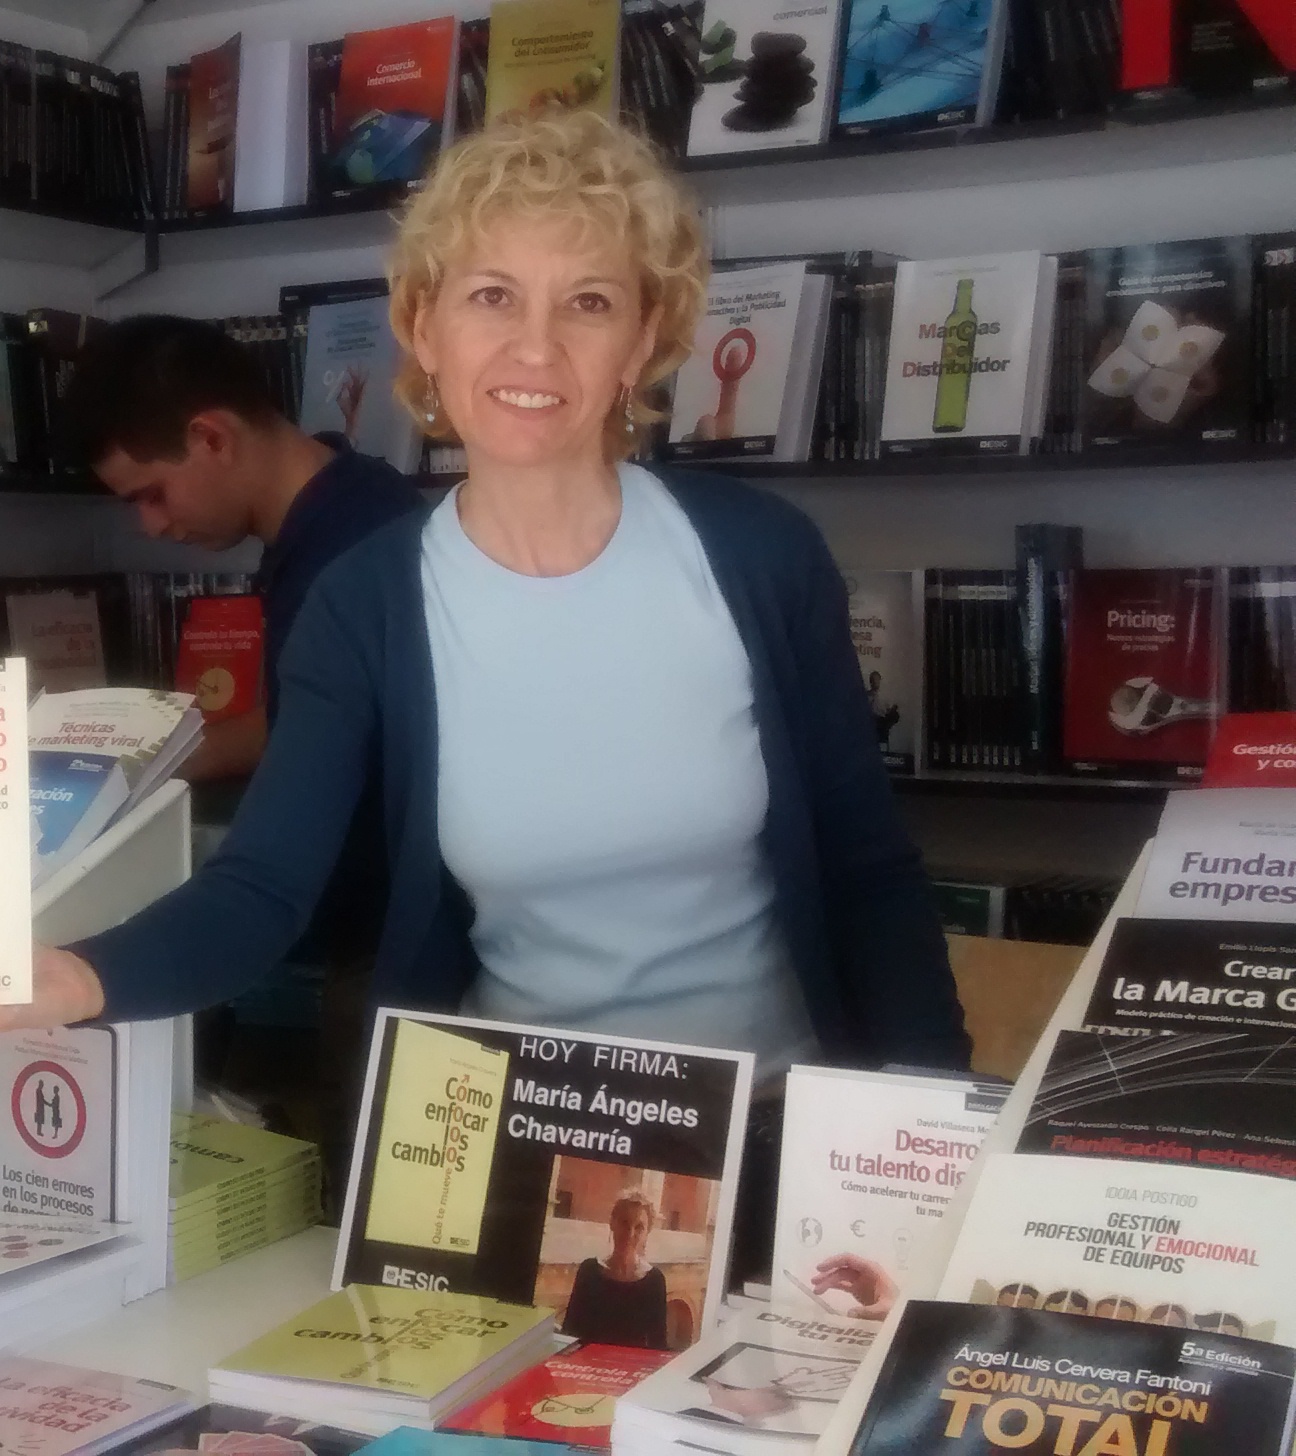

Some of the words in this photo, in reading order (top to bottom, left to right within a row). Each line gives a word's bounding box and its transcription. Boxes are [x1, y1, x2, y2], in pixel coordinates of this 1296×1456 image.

[514, 46, 530, 57] del
[366, 68, 422, 86] internacional
[375, 59, 416, 74] Comercio
[745, 291, 781, 302] Marketing
[750, 299, 787, 311] Publicidad
[729, 316, 751, 326] Digital
[902, 356, 1011, 378] Distribuidor
[1107, 610, 1176, 632] Pricing:
[58, 721, 116, 734] Técnicas
[37, 734, 110, 748] marketing
[111, 735, 145, 748] viral
[1232, 743, 1296, 756] Gestió
[1256, 760, 1270, 771] y
[1224, 960, 1296, 980] Crear
[1112, 977, 1146, 1001] la
[1154, 980, 1266, 1009] Marca
[1115, 1009, 1147, 1018] Modelo
[1148, 1010, 1183, 1020] práctico
[1184, 1013, 1196, 1021] de
[1197, 1013, 1234, 1023] creación
[519, 1036, 577, 1064] HOY
[593, 1047, 689, 1080] FIRMA:
[513, 1078, 582, 1111] María
[588, 1083, 699, 1128] Ángeles
[425, 1101, 489, 1133] enfocar
[916, 1118, 939, 1129] David
[940, 1121, 975, 1133] Villaseca
[1047, 1119, 1077, 1128] Raquel
[508, 1113, 633, 1157] Chavarría
[391, 1140, 465, 1172] cambios
[1050, 1134, 1192, 1161] Planificación
[830, 1149, 850, 1172] tu
[855, 1153, 930, 1183] talento
[2, 1164, 23, 1182] Los
[25, 1169, 49, 1188] cien
[51, 1178, 95, 1199] errores
[841, 1180, 868, 1195] Cómo
[869, 1184, 908, 1200] acelerar
[910, 1189, 920, 1202] tu
[2, 1185, 17, 1198] en
[20, 1185, 38, 1204] los
[40, 1193, 94, 1217] procesos
[436, 1207, 445, 1219] te
[441, 1167, 453, 1206] mueve
[1105, 1186, 1138, 1201] IDOIA
[1142, 1189, 1198, 1208] POSTIGO
[916, 1205, 926, 1216] tu
[928, 1208, 943, 1218] ma
[1106, 1211, 1181, 1236] GESTIÓN
[1024, 1221, 1137, 1249] PROFESIONAL
[1140, 1234, 1153, 1250] Y
[1155, 1236, 1260, 1267] EMOCIONAL
[1083, 1246, 1106, 1263] DE
[1110, 1248, 1186, 1274] EQUIPOS
[400, 1267, 449, 1293] ESIC
[369, 1315, 497, 1338] enfocar
[414, 1308, 509, 1329] Cómo
[294, 1328, 432, 1350] cambios
[798, 1329, 826, 1341] tu
[545, 1361, 629, 1376] Controla
[954, 1343, 1010, 1370] Ángel
[1011, 1351, 1051, 1371] Luis
[1054, 1357, 1130, 1384] Cervera
[1135, 1370, 1213, 1396] Fantoni
[1205, 1349, 1262, 1369] Edición
[550, 1371, 634, 1385] controla
[27, 1385, 132, 1413] eficacia
[945, 1365, 1209, 1423] COMUNICACIÓN
[38, 1401, 78, 1413] de
[77, 1408, 109, 1423] la
